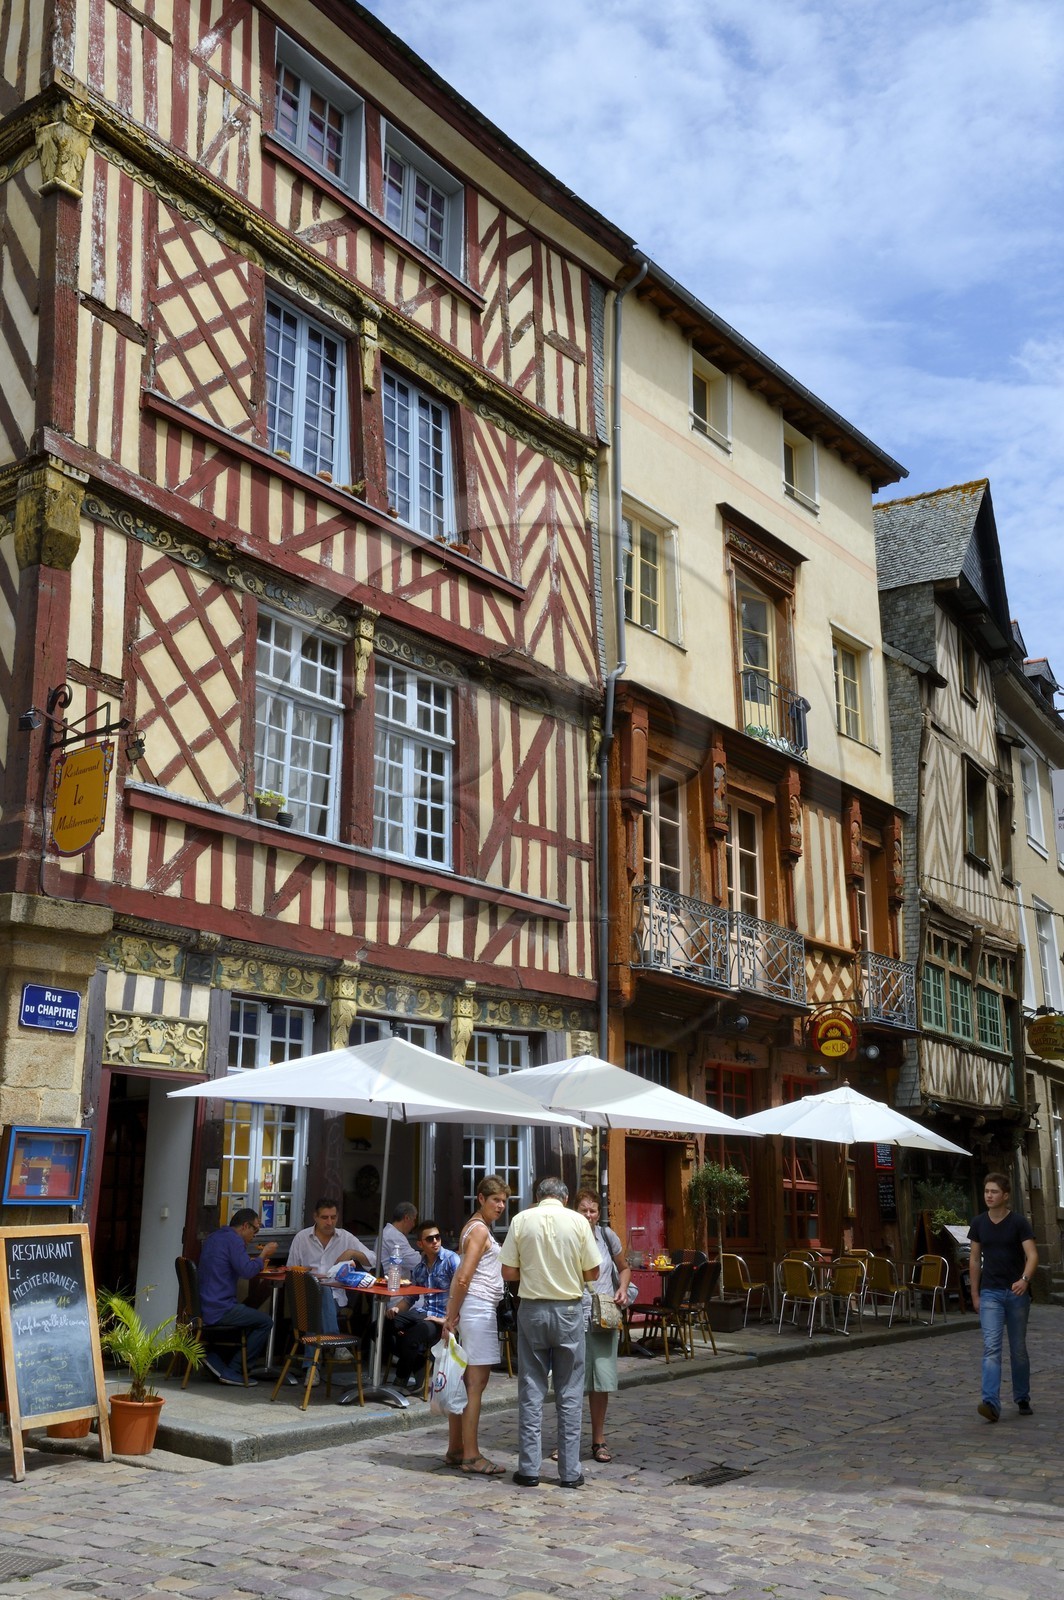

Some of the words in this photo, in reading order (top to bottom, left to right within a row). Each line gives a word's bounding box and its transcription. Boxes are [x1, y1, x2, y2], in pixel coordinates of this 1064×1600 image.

[63, 759, 100, 780] Restaurant
[73, 784, 84, 806] le
[189, 958, 211, 978] 22
[25, 1004, 35, 1013] DU
[37, 1004, 77, 1020] CHAPITRE
[831, 1043, 847, 1053] KUB
[12, 1241, 74, 1262] RESTAURANT
[8, 1265, 21, 1280] LE
